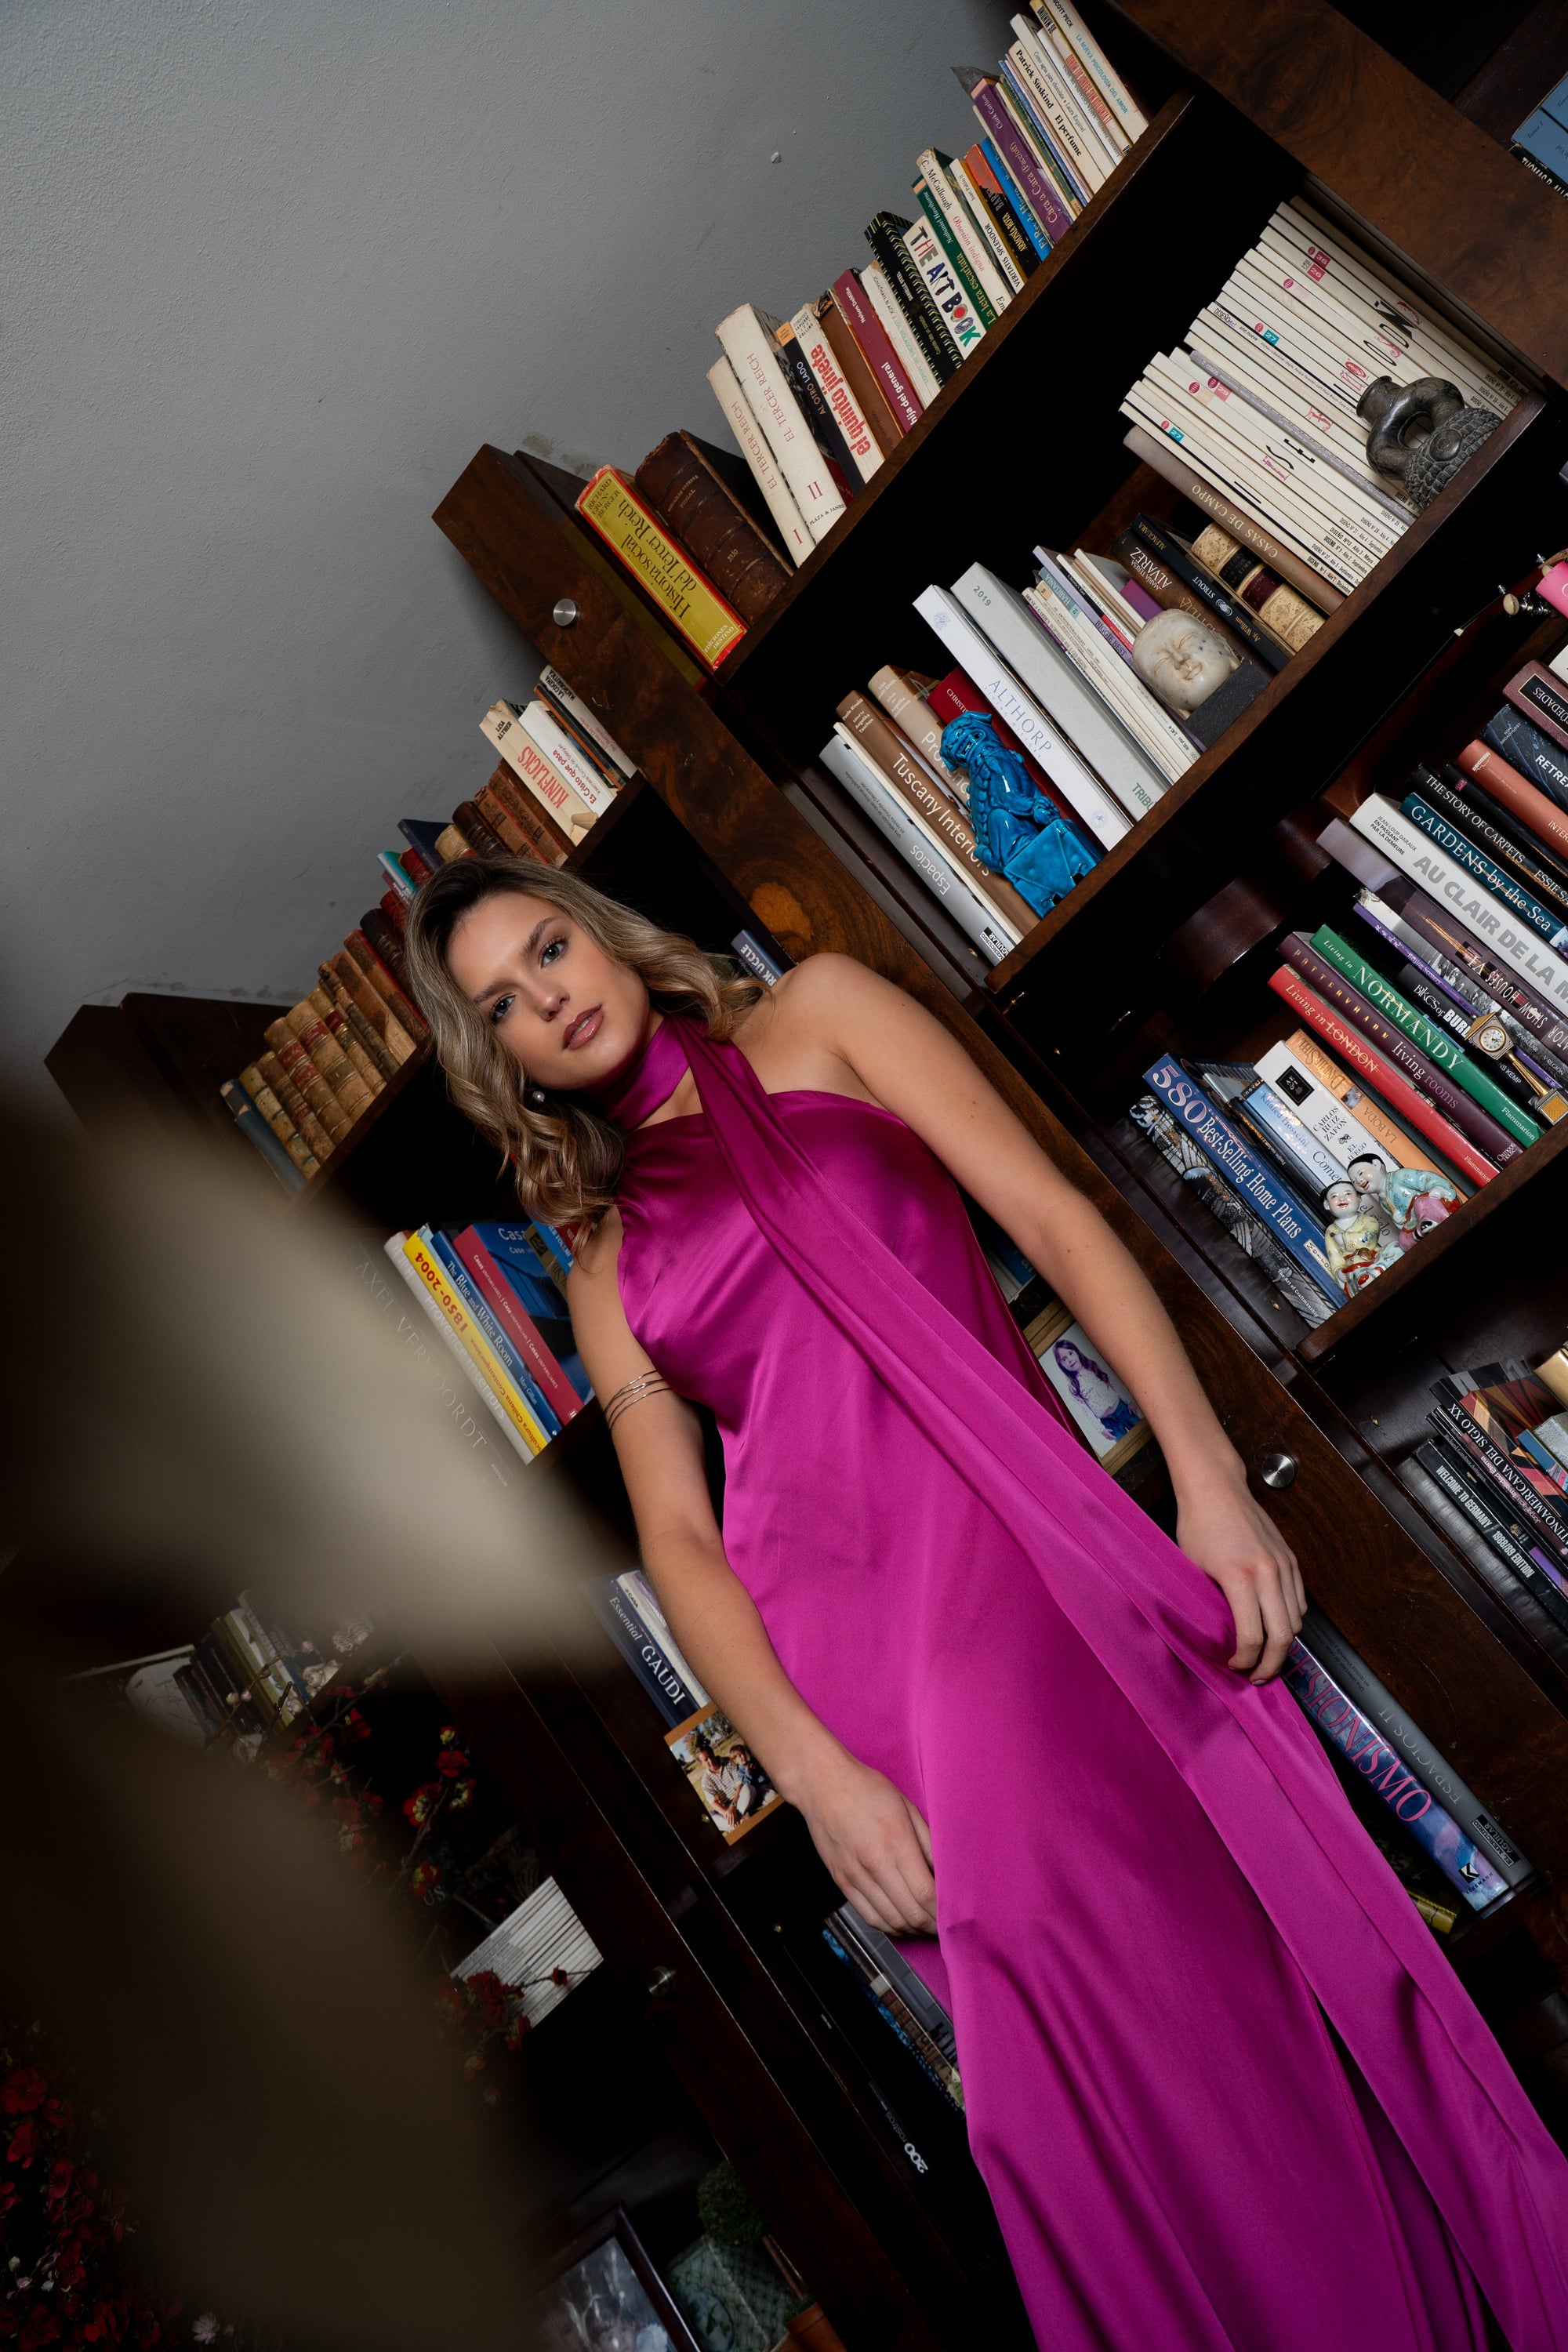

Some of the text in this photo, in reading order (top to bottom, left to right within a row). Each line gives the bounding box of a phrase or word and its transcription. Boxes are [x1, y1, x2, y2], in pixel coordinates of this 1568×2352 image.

[1014, 49, 1036, 78] Patrick
[1079, 41, 1128, 114] NUEVA DEL AMOR
[1031, 78, 1054, 109] Süskind
[1051, 81, 1076, 115] chocolate Laura
[1054, 114, 1063, 123] El
[1057, 122, 1083, 158] perfume
[924, 168, 956, 211] McCullough
[1022, 172, 1044, 196] Cara
[1000, 212, 1014, 228] ROTA
[1038, 199, 1060, 224] Cara
[935, 218, 954, 244] Nathaniel
[950, 215, 986, 272] Obsesión indigna
[982, 223, 1022, 287] VERITATIS SPLENDOR
[902, 224, 985, 348] THE BOOK
[952, 252, 996, 325] La letra escarlata
[852, 305, 867, 323] Nelson
[744, 352, 796, 441] EL TERCER REICH
[793, 360, 827, 415] AL OTRO LADO
[800, 342, 873, 457] el quinto jinete
[880, 361, 910, 408] del general
[728, 401, 779, 489] EL TERCER REICH
[586, 477, 613, 510] RICHARD
[597, 488, 621, 518] BERGER
[612, 497, 653, 538] Reich
[1135, 521, 1168, 550] ALFAGUARA
[1190, 483, 1279, 558] CASAS DE CAMPO
[618, 532, 656, 570] social
[642, 531, 686, 576] Tercer
[1362, 553, 1374, 564] Mayo
[1367, 539, 1384, 554] Septiembre
[674, 568, 699, 591] del
[1127, 559, 1148, 577] TERESA
[641, 563, 694, 619] Historia
[972, 585, 992, 607] 2019
[1044, 573, 1070, 604] HABITANIA
[1190, 575, 1217, 599] STROUT
[712, 625, 734, 649] DESTINO
[1232, 615, 1254, 634] William
[1108, 636, 1127, 657] BEST
[543, 674, 561, 692] COCINA
[495, 720, 505, 732] LISA
[496, 720, 512, 740] ALTHER
[855, 713, 870, 729] Angelika
[858, 717, 874, 733] Taschen
[987, 675, 1053, 756] ALTHORP
[1499, 721, 1522, 745] BROADHURST
[1503, 726, 1512, 735] RON
[514, 744, 572, 810] KINFLICKS
[551, 748, 597, 804] Es Cristo que pasa
[887, 751, 946, 815] Tuscany
[877, 803, 901, 829] revista Vivienda
[1373, 818, 1399, 843] EN PASSANT
[1376, 815, 1417, 851] JEAN-LOUP DARAUX
[1423, 774, 1560, 894] THE STORY OF CARPETS ESSIE
[1369, 822, 1380, 833] PAR
[1383, 835, 1406, 855] DEMEURE
[909, 843, 953, 895] Espacios
[1406, 803, 1555, 931] GARDENS by the Sea
[1412, 852, 1559, 986] AU CLAIR DE LA
[1321, 938, 1469, 1073] Living in NORMANDY
[1483, 974, 1544, 1029] SHOW HOUSES
[1282, 982, 1379, 1073] Living in LONDON
[1515, 1031, 1539, 1053] ZAPALLAR
[1388, 1040, 1460, 1109] living rooms
[1257, 1093, 1285, 1120] Khaled
[1278, 1115, 1312, 1147] Hosseini
[1312, 1104, 1338, 1132] CARLOS
[1321, 1113, 1340, 1134] RUIZ
[1361, 1107, 1398, 1143] LA BODA
[1501, 1106, 1537, 1140] Flammarion
[1149, 1060, 1211, 1127] 580
[1193, 1116, 1257, 1185] Best-Selling
[1245, 1172, 1282, 1211] Home
[1270, 1201, 1307, 1240] Plans
[1461, 1155, 1493, 1183] Flammarion
[354, 1258, 395, 1311] AXEL
[1276, 1268, 1286, 1278] The
[1283, 1276, 1292, 1286] Art
[445, 1260, 515, 1367] The Blue and White Room
[472, 1254, 541, 1359] Casas Case Casas
[412, 1249, 524, 1423] Chilena 1850-2004
[516, 1375, 529, 1390] Mary
[1446, 1403, 1504, 1468] DEL SIGLO XX
[1444, 1433, 1486, 1482] Richard Gardner Antiques
[1435, 1465, 1535, 1578] WELCOME TO GERMANY 1988/89 EDITION
[627, 1592, 639, 1608] CASA
[608, 1595, 687, 1706] Essential GAUDI
[1471, 1818, 1504, 1855] MERCURIO
[1483, 1820, 1515, 1857] AGUILAR
[883, 2111, 929, 2176] 200 rostros
